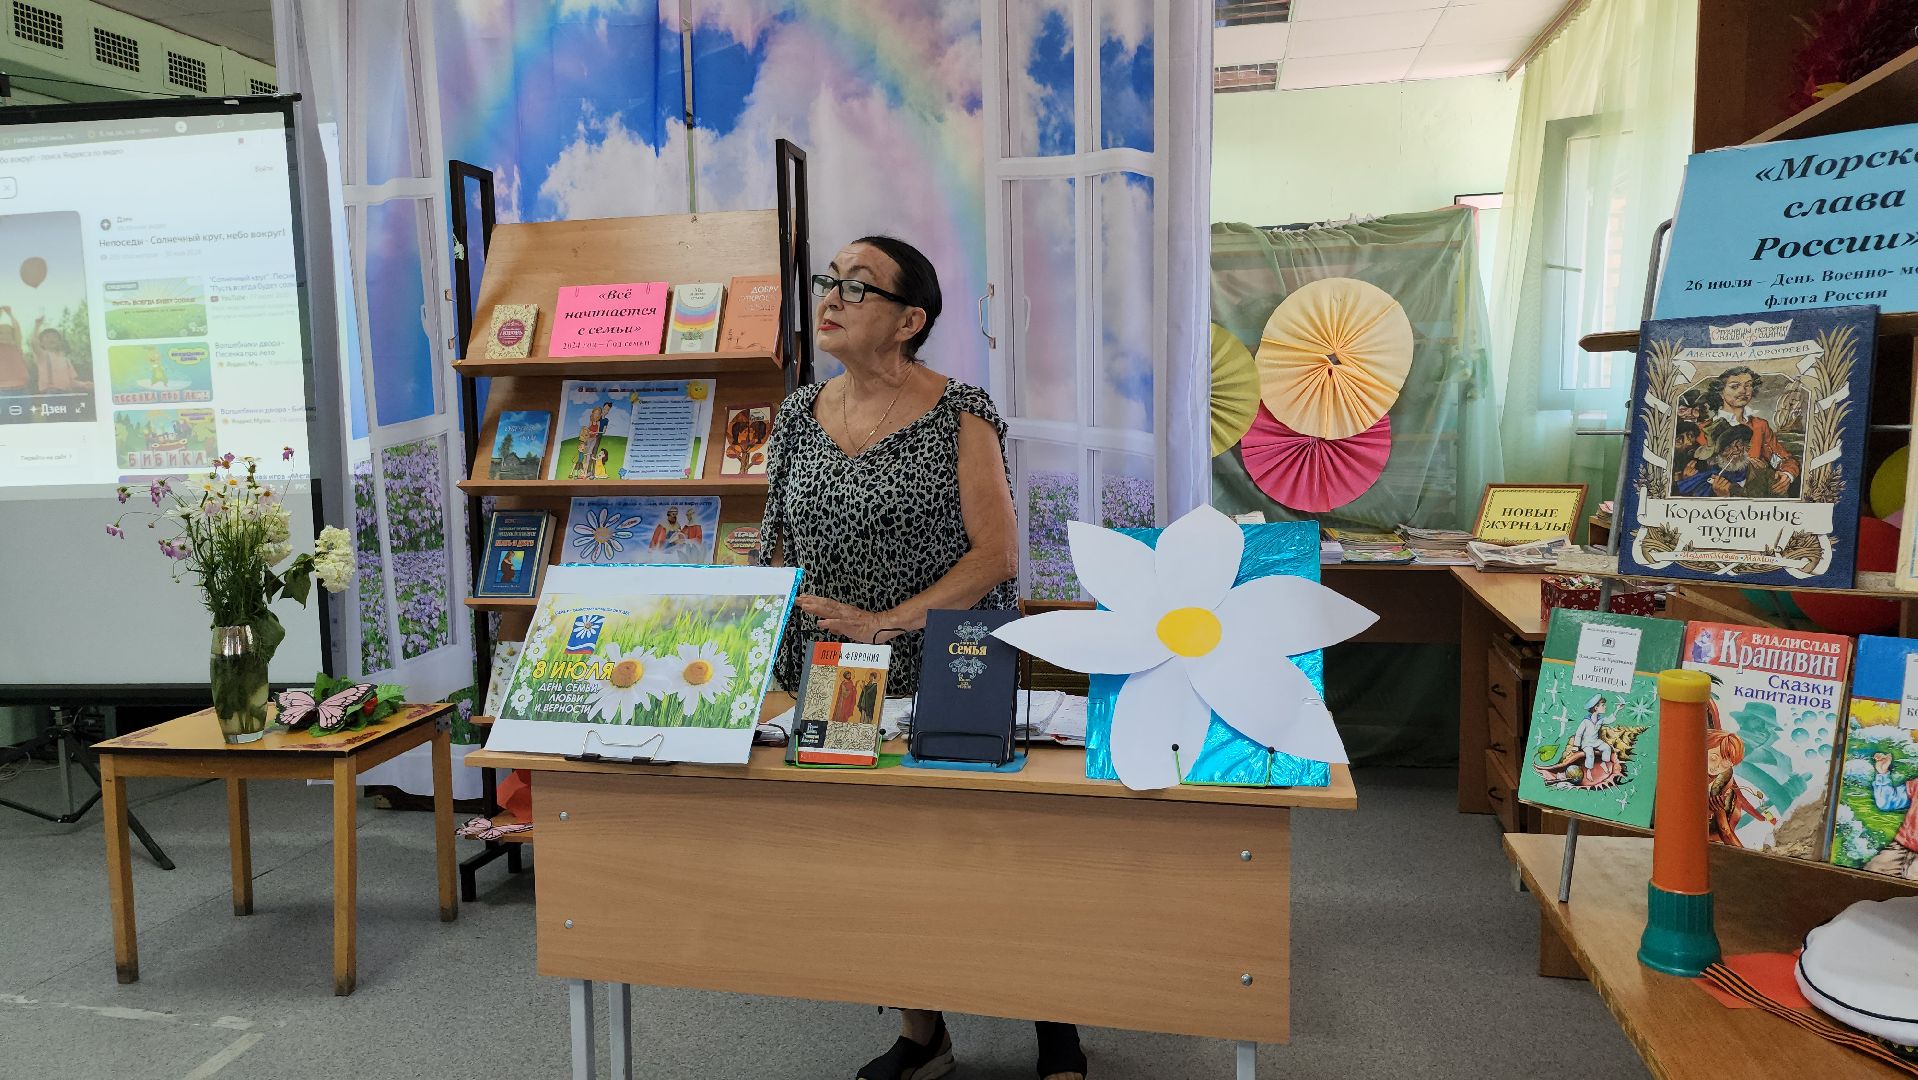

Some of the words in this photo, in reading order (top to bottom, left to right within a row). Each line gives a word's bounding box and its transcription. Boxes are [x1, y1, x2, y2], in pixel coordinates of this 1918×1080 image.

[1755, 147, 1918, 181] «Морск
[1783, 188, 1906, 218] слава
[99, 238, 144, 248] Непоседы
[150, 233, 201, 245] Солнечный
[226, 231, 249, 241] небо
[250, 229, 286, 241] вокруг!
[1750, 231, 1918, 261] России»
[1684, 279, 1703, 291] 26
[1708, 278, 1752, 290] июля
[1770, 273, 1815, 288] День
[1822, 269, 1894, 283] Военно-
[598, 289, 632, 300] «Всё
[1764, 291, 1817, 309] флота
[1823, 288, 1888, 303] России
[565, 307, 657, 319] начинается
[577, 327, 585, 336] с
[589, 326, 641, 336] семьи»
[41, 403, 67, 416] Дзен
[128, 451, 206, 468] БИБИКА
[1502, 508, 1558, 517] НОВЫЕ
[1663, 503, 1803, 525] Корабельные
[1486, 521, 1568, 531] ЖУРНАЛЫ
[1752, 634, 1841, 654] ВЛАДИСЛАВ
[821, 650, 837, 660] ПЕТР
[845, 651, 880, 663] ФЕВРОНИЯ
[1719, 630, 1839, 678] Крапивин
[532, 660, 547, 680] 8
[549, 661, 615, 680] ИЮЛЯ
[538, 682, 562, 692] ДЕНЬ
[565, 683, 599, 694] СЕМЬИ,
[1768, 675, 1834, 696] Сказки
[548, 693, 584, 703] ЛЮБВИ
[1734, 686, 1832, 709] капитанов
[534, 704, 541, 712] И
[543, 704, 591, 714] ВЕРНОСТИ
